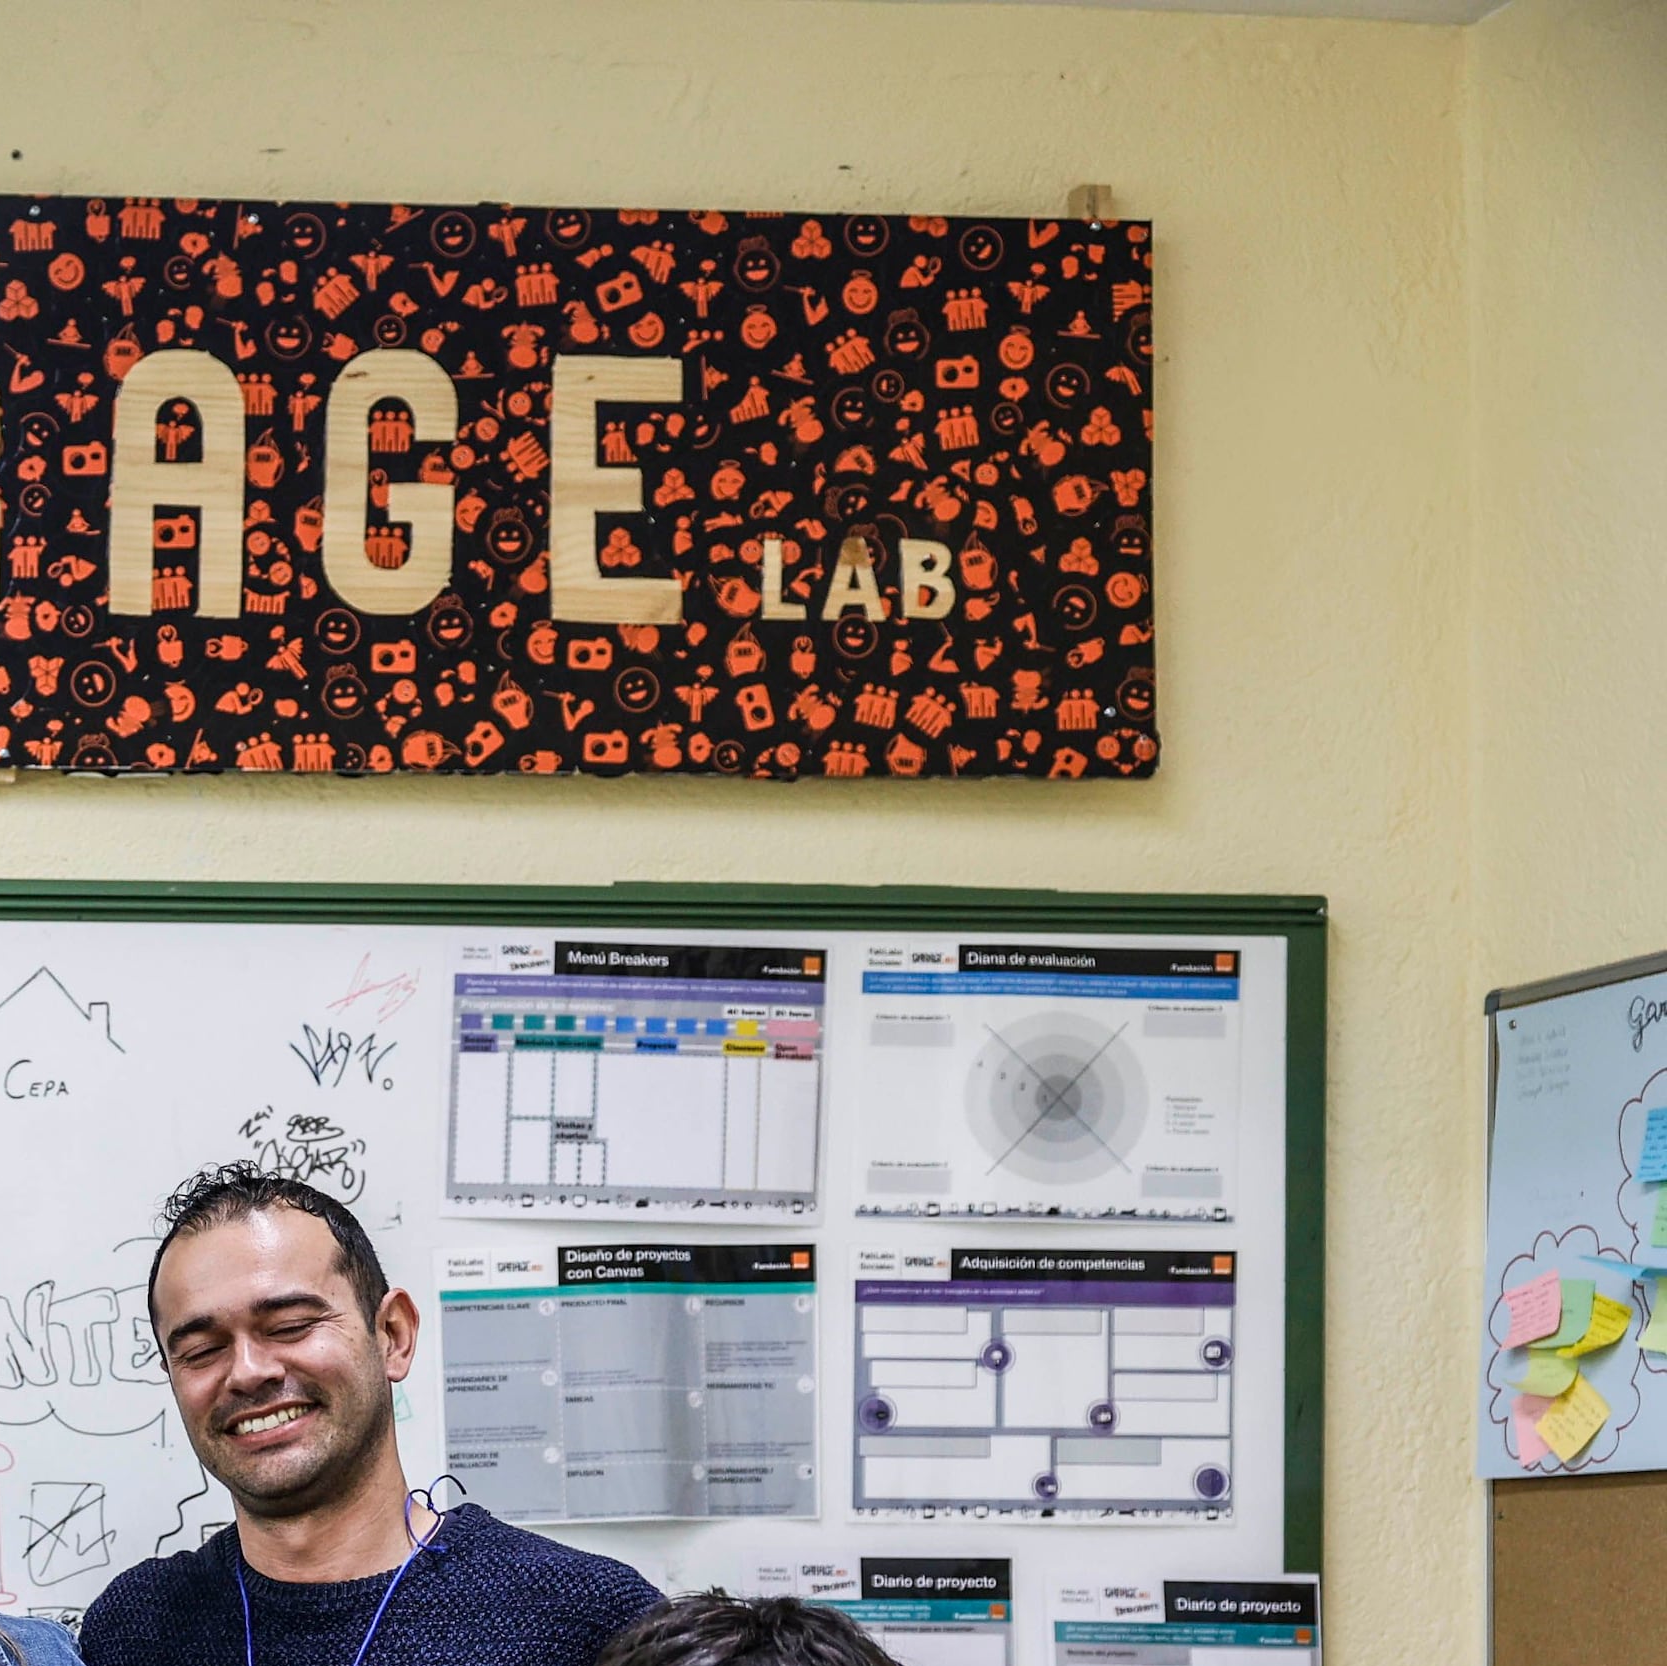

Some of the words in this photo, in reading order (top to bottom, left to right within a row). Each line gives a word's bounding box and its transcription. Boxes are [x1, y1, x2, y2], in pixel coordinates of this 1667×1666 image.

[762, 537, 955, 623] LAB
[567, 949, 607, 966] Menú
[609, 951, 671, 968] Breakers
[967, 951, 1007, 966] Diana
[1010, 952, 1027, 966] de
[1029, 953, 1096, 969] evaluación
[565, 1249, 613, 1264] Diseño
[615, 1249, 633, 1263] de
[635, 1248, 692, 1265] proyectos
[959, 1256, 1036, 1272] Adquisición
[1038, 1257, 1055, 1270] de
[1057, 1258, 1146, 1274] competencias
[565, 1268, 593, 1281] con
[595, 1264, 645, 1280] Canvas
[873, 1573, 914, 1589] Diario
[917, 1574, 934, 1588] de
[937, 1574, 998, 1592] proyecto
[1175, 1596, 1217, 1613] Diario
[1217, 1598, 1237, 1613] de
[1240, 1598, 1302, 1616] proyecto
